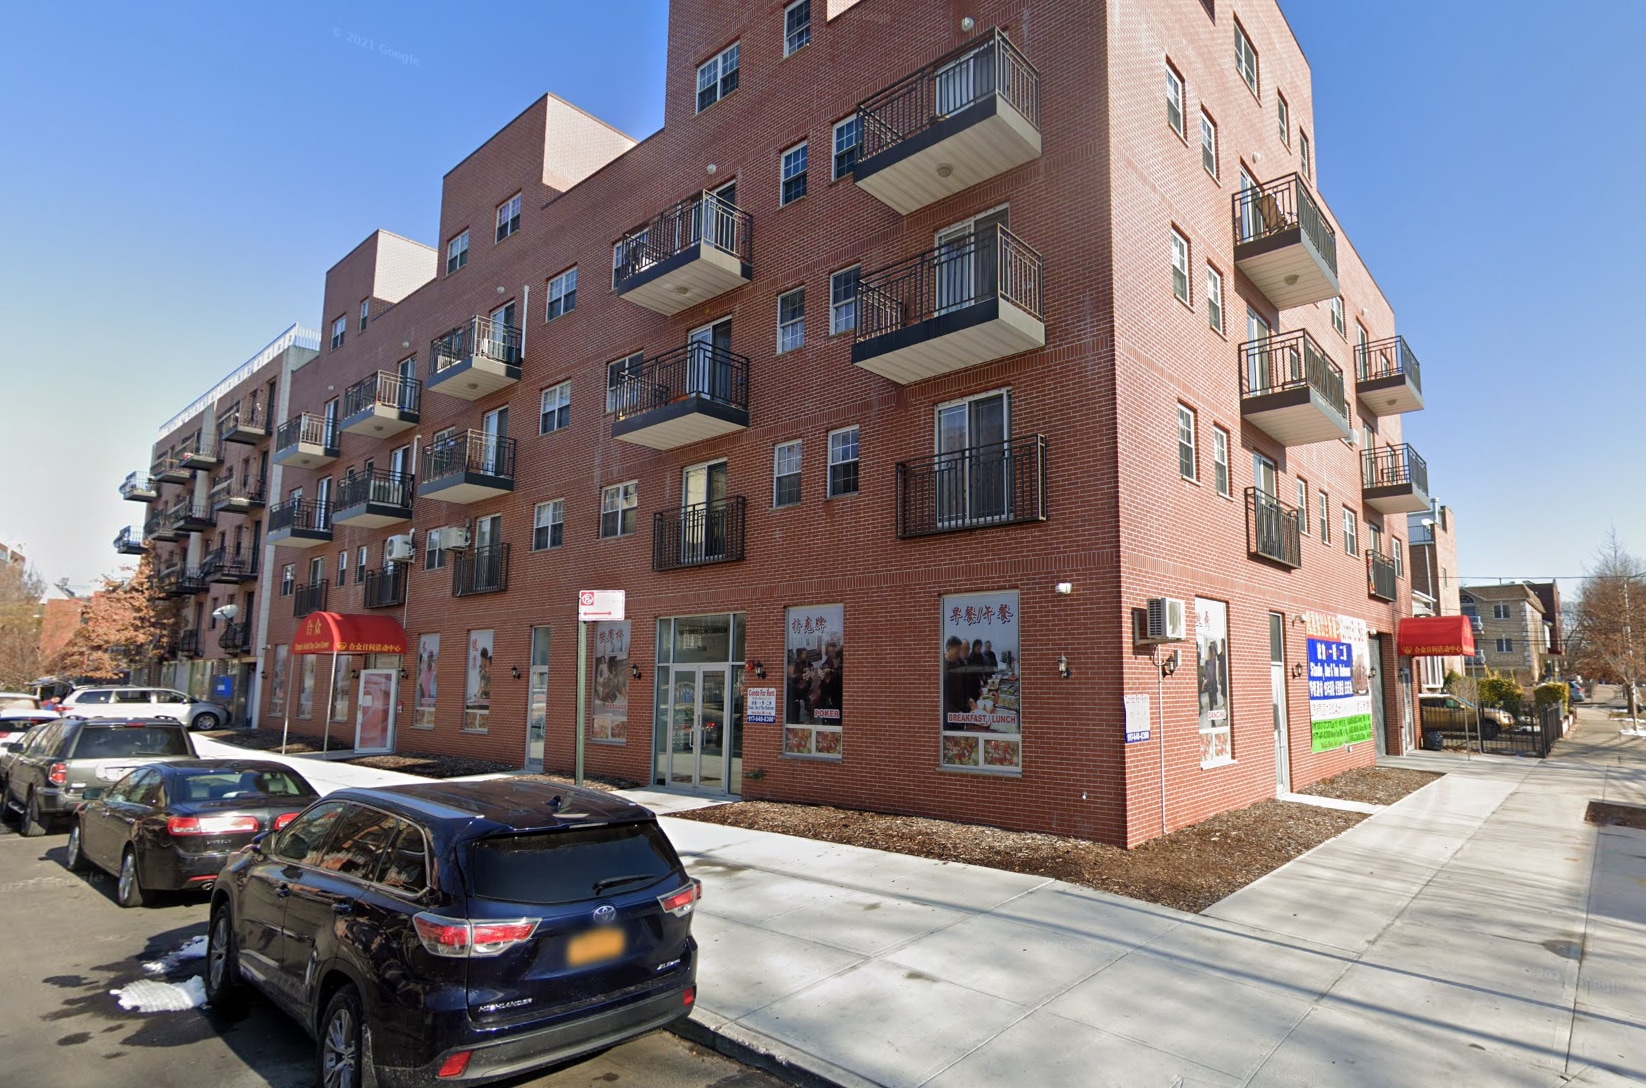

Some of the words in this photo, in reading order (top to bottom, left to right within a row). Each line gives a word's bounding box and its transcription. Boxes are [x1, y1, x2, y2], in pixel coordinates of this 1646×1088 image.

[814, 709, 840, 718] POKER
[948, 713, 987, 723] BREAKFAST
[991, 714, 1016, 724] LUNCH
